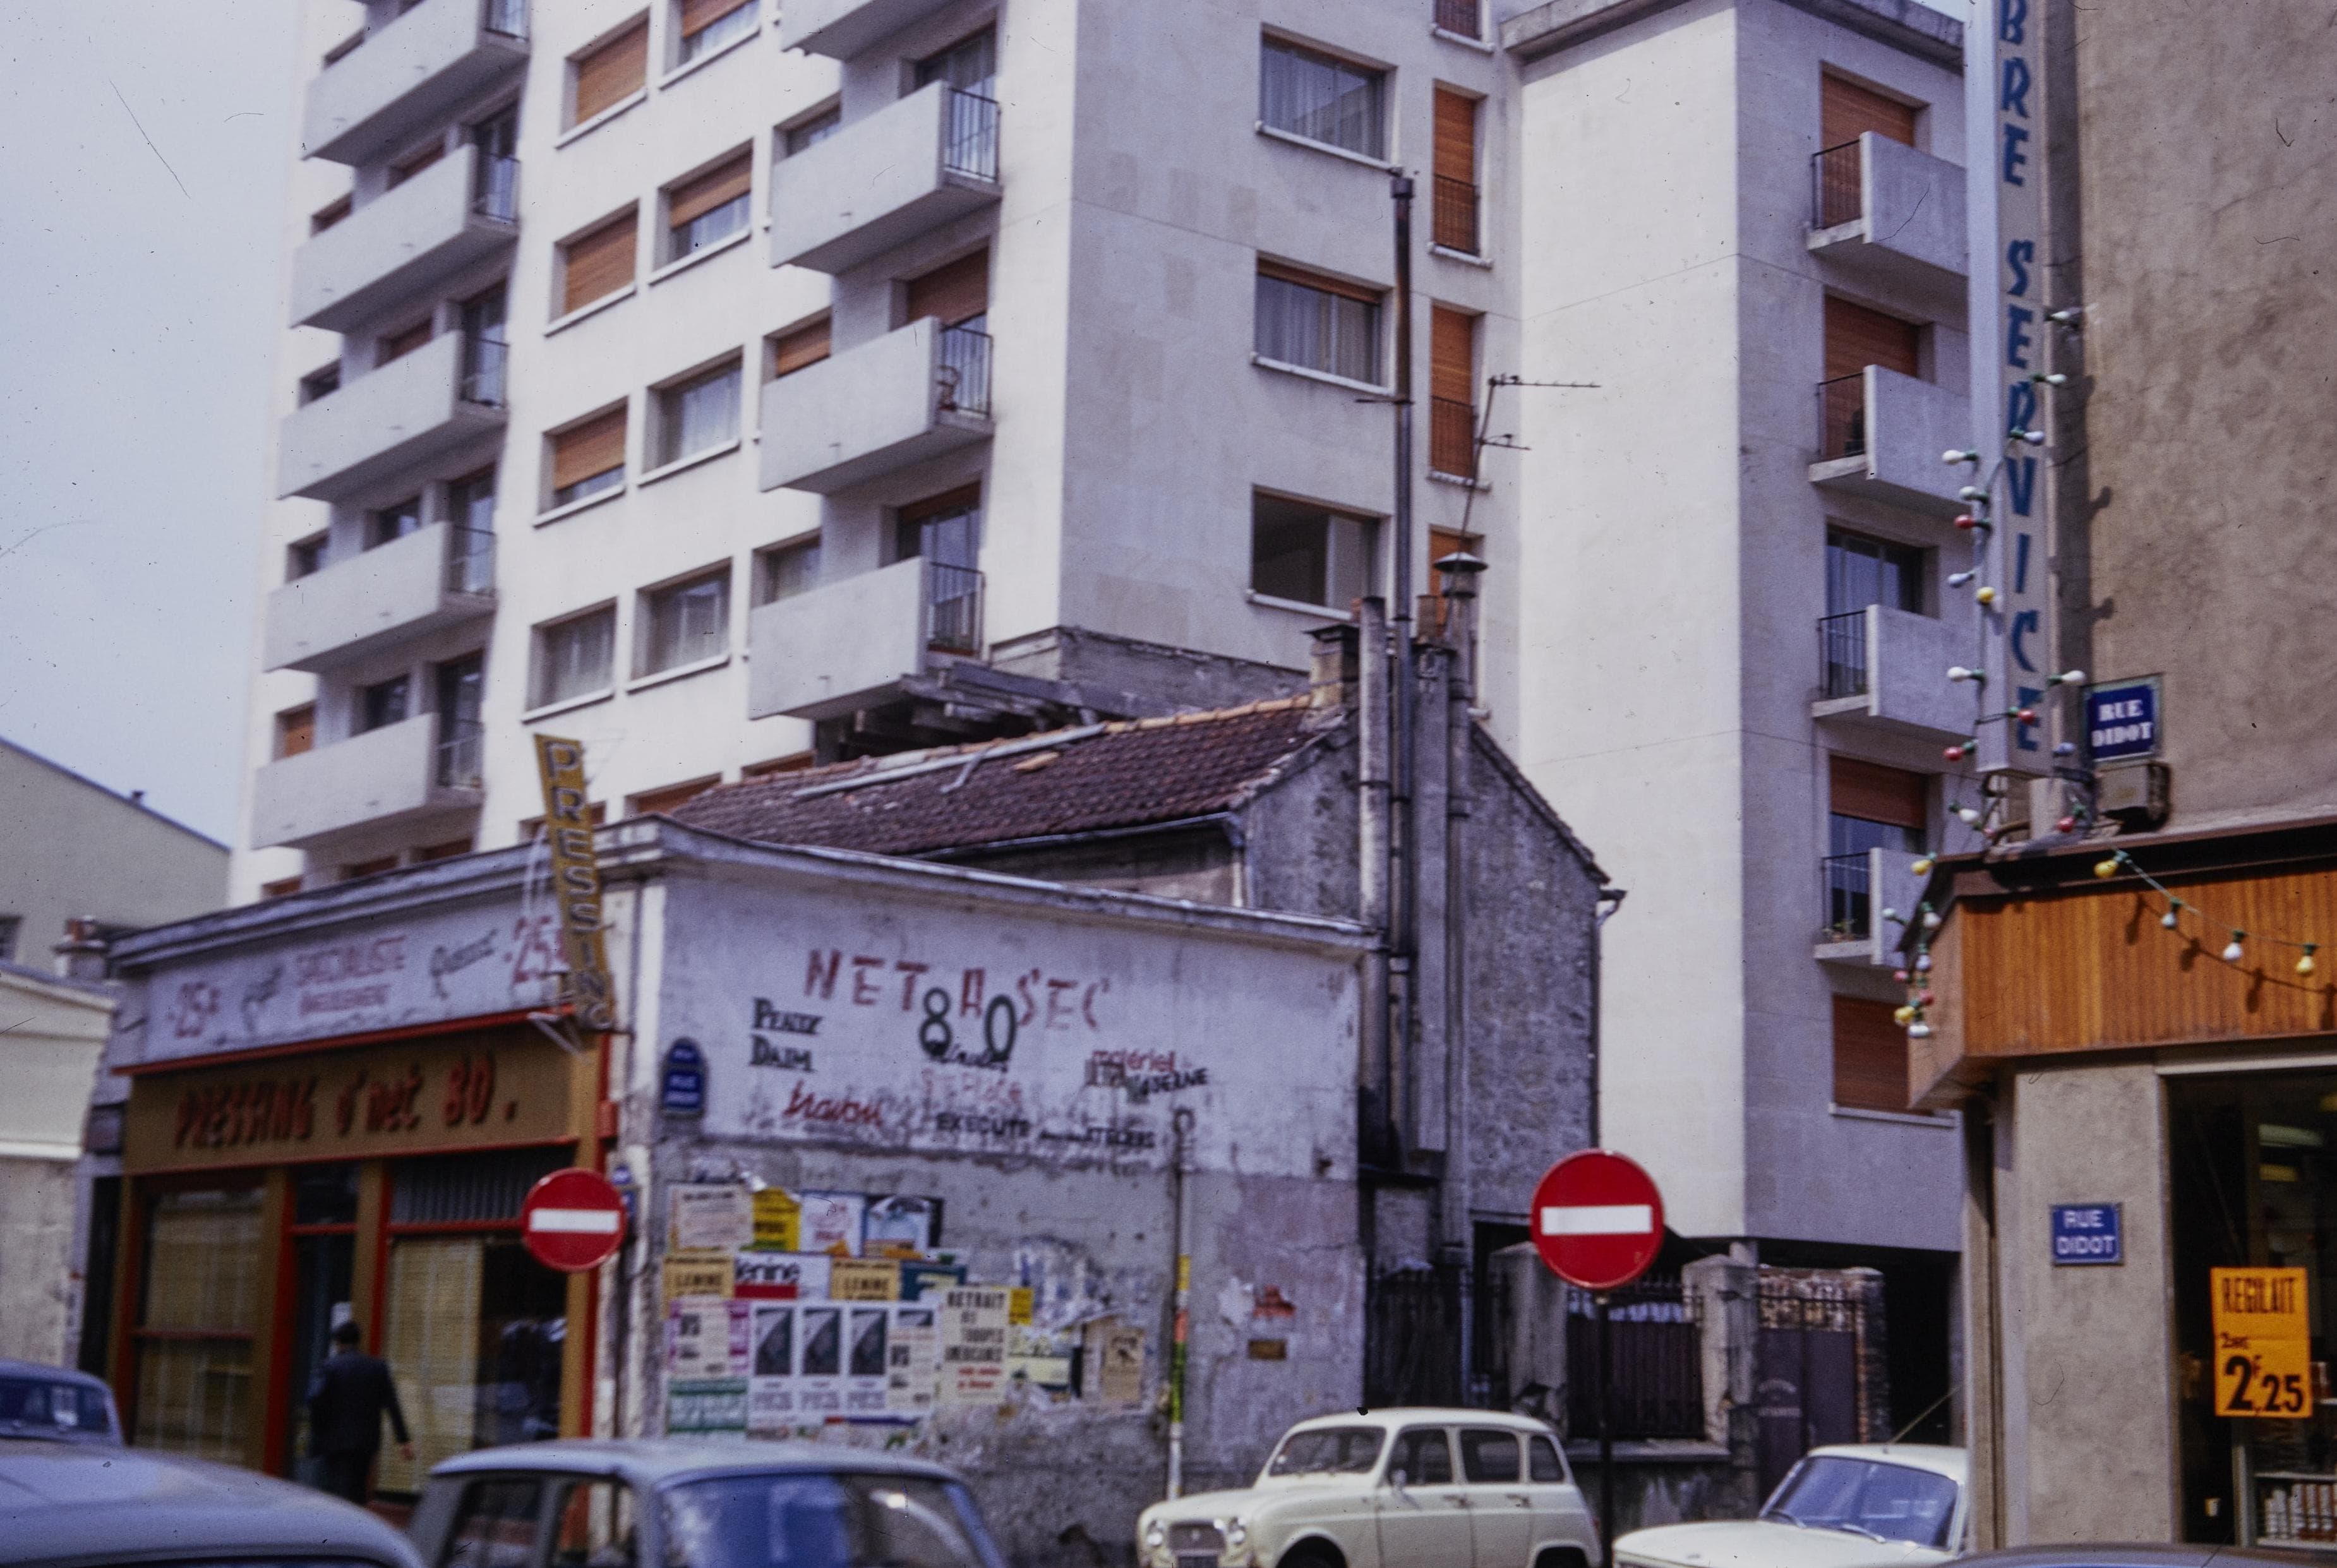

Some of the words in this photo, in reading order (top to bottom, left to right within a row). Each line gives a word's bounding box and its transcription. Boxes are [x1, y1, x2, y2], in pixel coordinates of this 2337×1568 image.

[2006, 239, 2045, 751] SERVICE
[2098, 699, 2144, 722] RUE
[2091, 721, 2153, 747] DIDOT
[544, 739, 611, 1029] PRESSING
[804, 949, 930, 1012] NET
[1016, 967, 1110, 1031] SEC
[918, 987, 1018, 1063] 80
[2062, 1209, 2105, 1229] RUE
[2056, 1235, 2115, 1255] DIDOT
[948, 1293, 1006, 1309] RETRAIT
